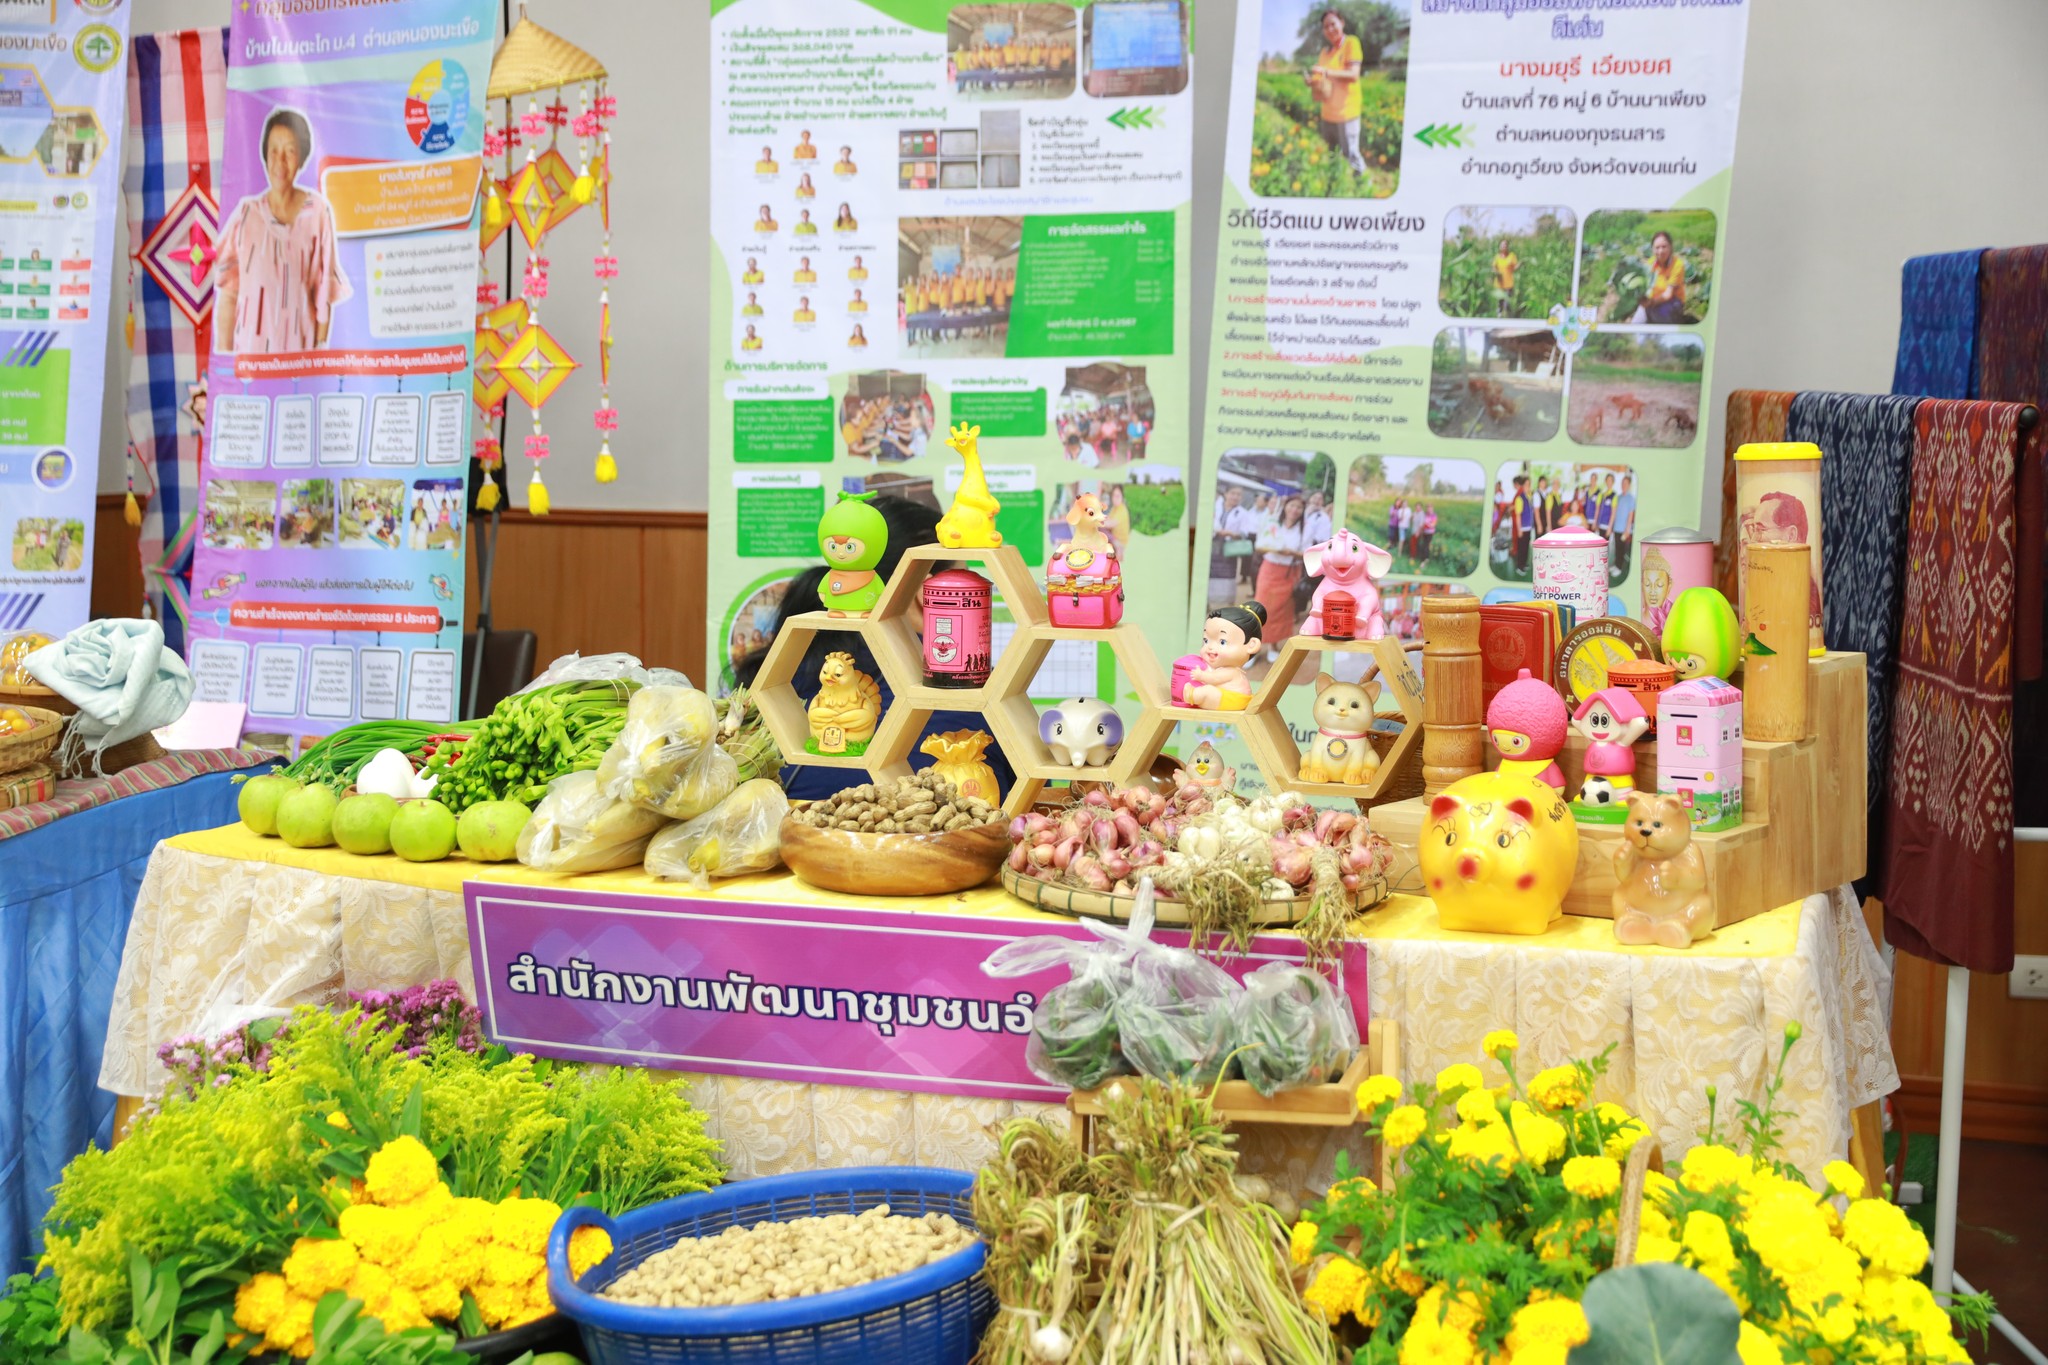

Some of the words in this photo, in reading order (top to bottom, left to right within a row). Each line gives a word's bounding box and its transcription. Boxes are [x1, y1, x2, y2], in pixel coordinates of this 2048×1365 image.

[1551, 15, 1604, 40] ดีเด่น
[1499, 54, 1582, 83] นางมยุรี
[1591, 55, 1672, 78] เวียงยศ
[1461, 87, 1535, 110] บ้านเลขที่
[1537, 93, 1558, 110] 76
[1563, 90, 1587, 114] หมู่
[1591, 93, 1601, 109] 6
[1606, 91, 1707, 109] บ้านนาเพียง
[1496, 122, 1666, 147] ตำบลหนองกุงธนสาร
[1461, 157, 1563, 181] อำเภอภูเวียง
[1568, 156, 1697, 176] จังหวัดขอนแก่น
[1227, 207, 1324, 230] วิถีชีวิตแบ
[1328, 211, 1426, 232] บพอเพียง
[962, 597, 982, 608] สิน
[1548, 592, 1581, 601] POWER
[1559, 623, 1621, 678] ธนาคารออมสิน
[1643, 682, 1662, 692] สิน
